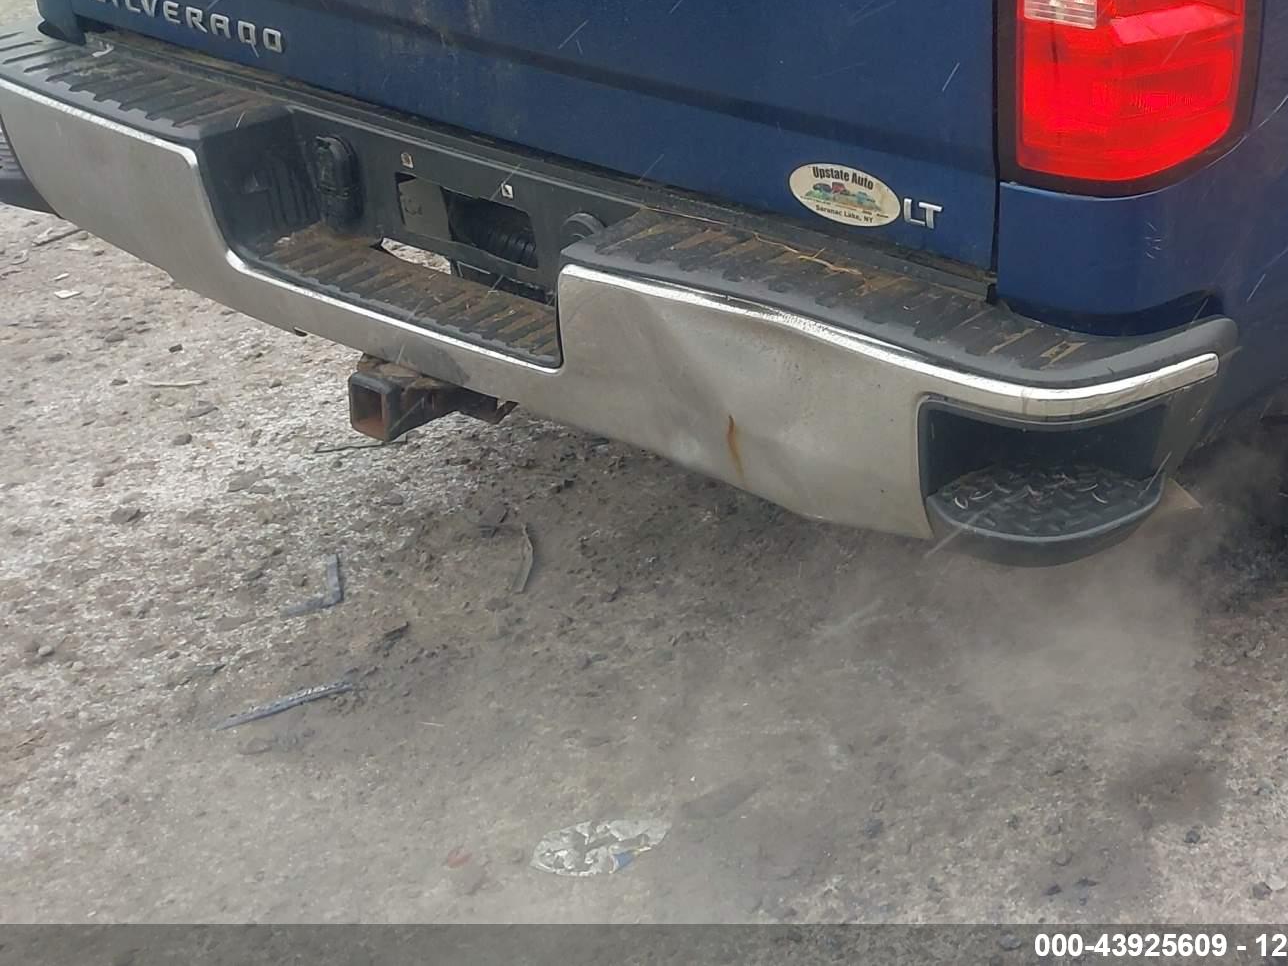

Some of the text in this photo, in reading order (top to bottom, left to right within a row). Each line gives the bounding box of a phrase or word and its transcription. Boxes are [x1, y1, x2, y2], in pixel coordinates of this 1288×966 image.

[812, 165, 874, 191] Upstate Auto
[815, 204, 843, 217] Saranac
[863, 215, 874, 224] NY
[903, 197, 943, 230] LT
